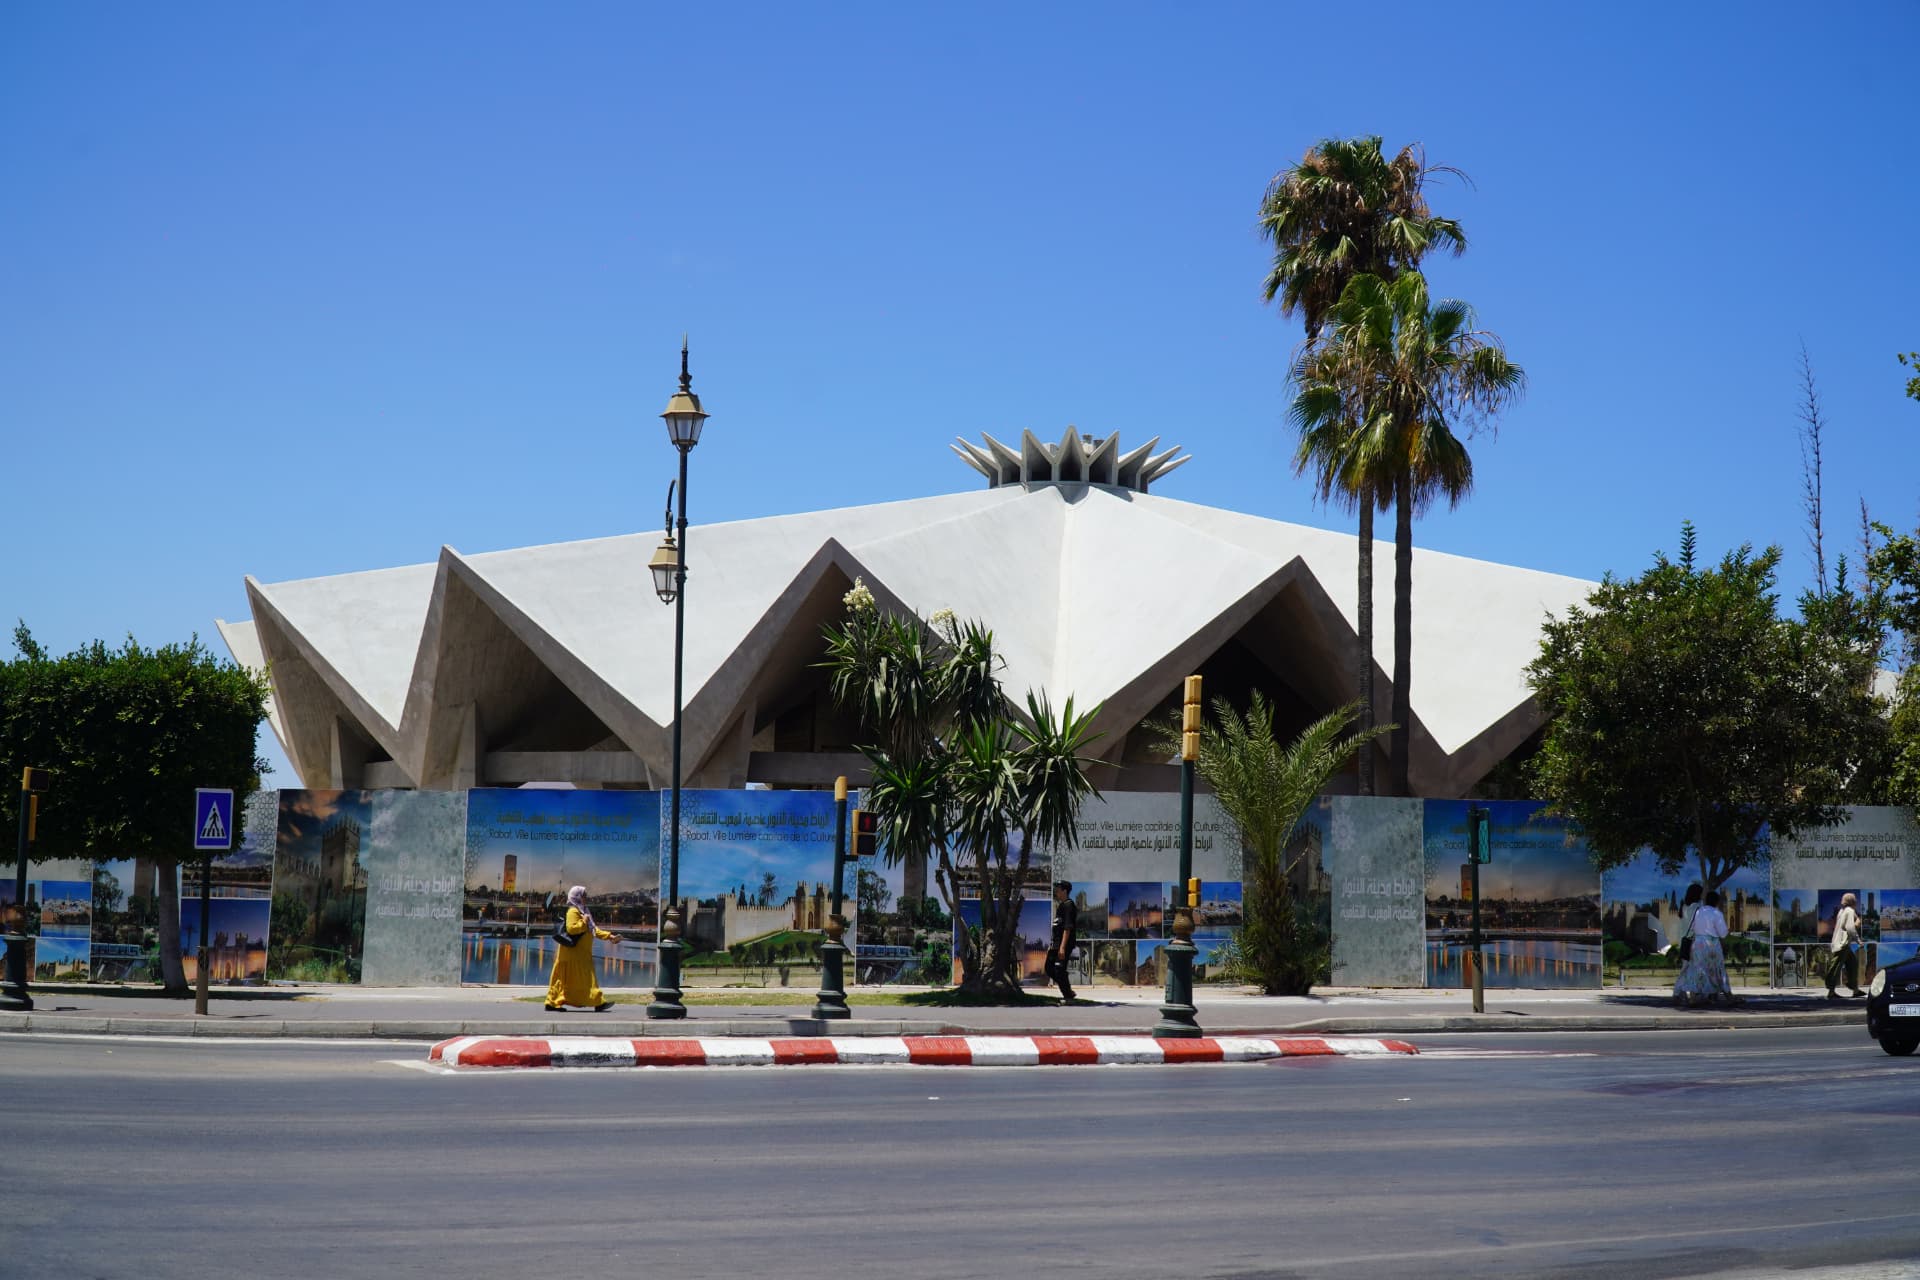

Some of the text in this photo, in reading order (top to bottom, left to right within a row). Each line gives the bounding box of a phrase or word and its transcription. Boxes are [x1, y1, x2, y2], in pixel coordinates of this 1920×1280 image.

[1144, 820, 1174, 832] capitale
[1193, 821, 1220, 832] Culture
[1106, 835, 1130, 852] المغرب
[1195, 835, 1213, 852] الرباط
[432, 873, 457, 896] الرباط
[1393, 877, 1416, 898] الرباط
